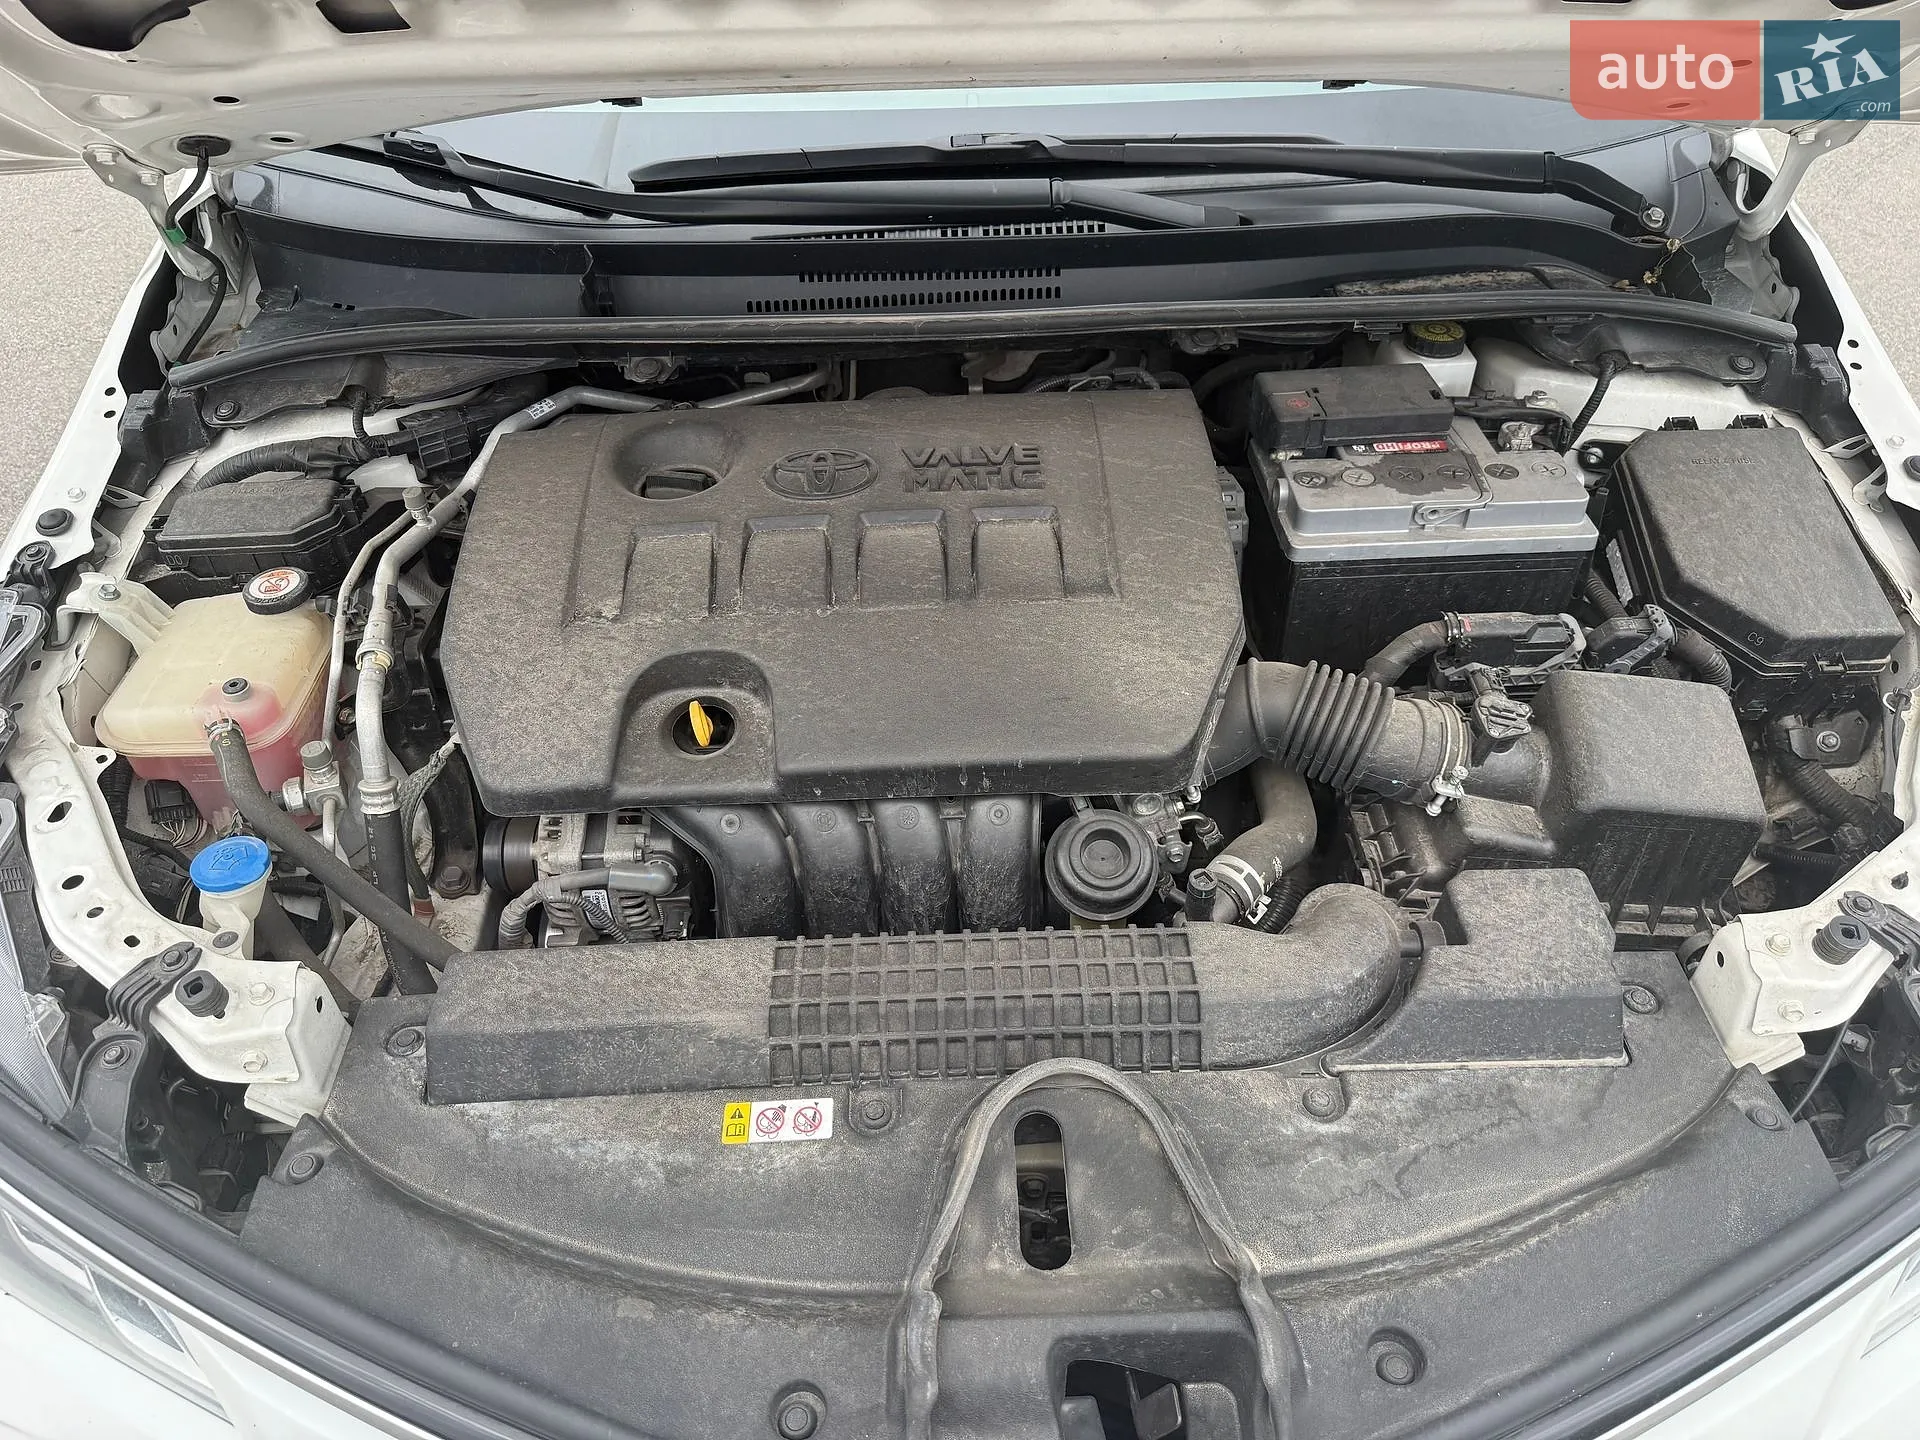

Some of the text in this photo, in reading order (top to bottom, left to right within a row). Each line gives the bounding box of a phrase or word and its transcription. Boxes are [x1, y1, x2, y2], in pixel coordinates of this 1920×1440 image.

[900, 443, 1042, 468] VALVE
[902, 464, 1045, 493] MATIC
[1747, 631, 1765, 647] C9
